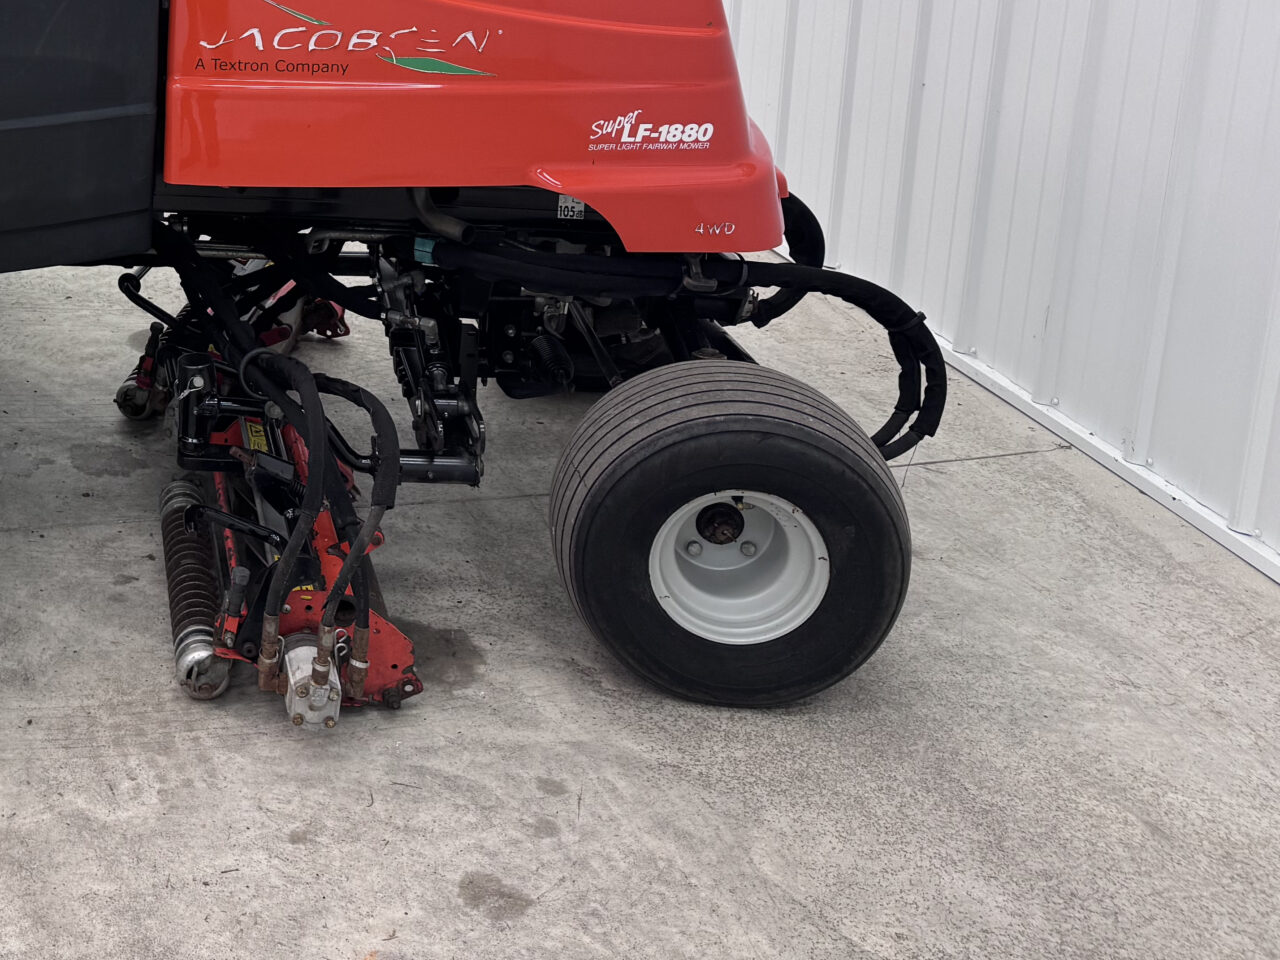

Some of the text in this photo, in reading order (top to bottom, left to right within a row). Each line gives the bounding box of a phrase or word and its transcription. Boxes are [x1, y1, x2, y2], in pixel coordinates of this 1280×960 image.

[195, 58, 350, 75] A Textron Company
[589, 109, 643, 140] Super
[620, 122, 714, 142] LF-1880
[588, 143, 616, 151] SUPER
[679, 142, 710, 150] MOWER
